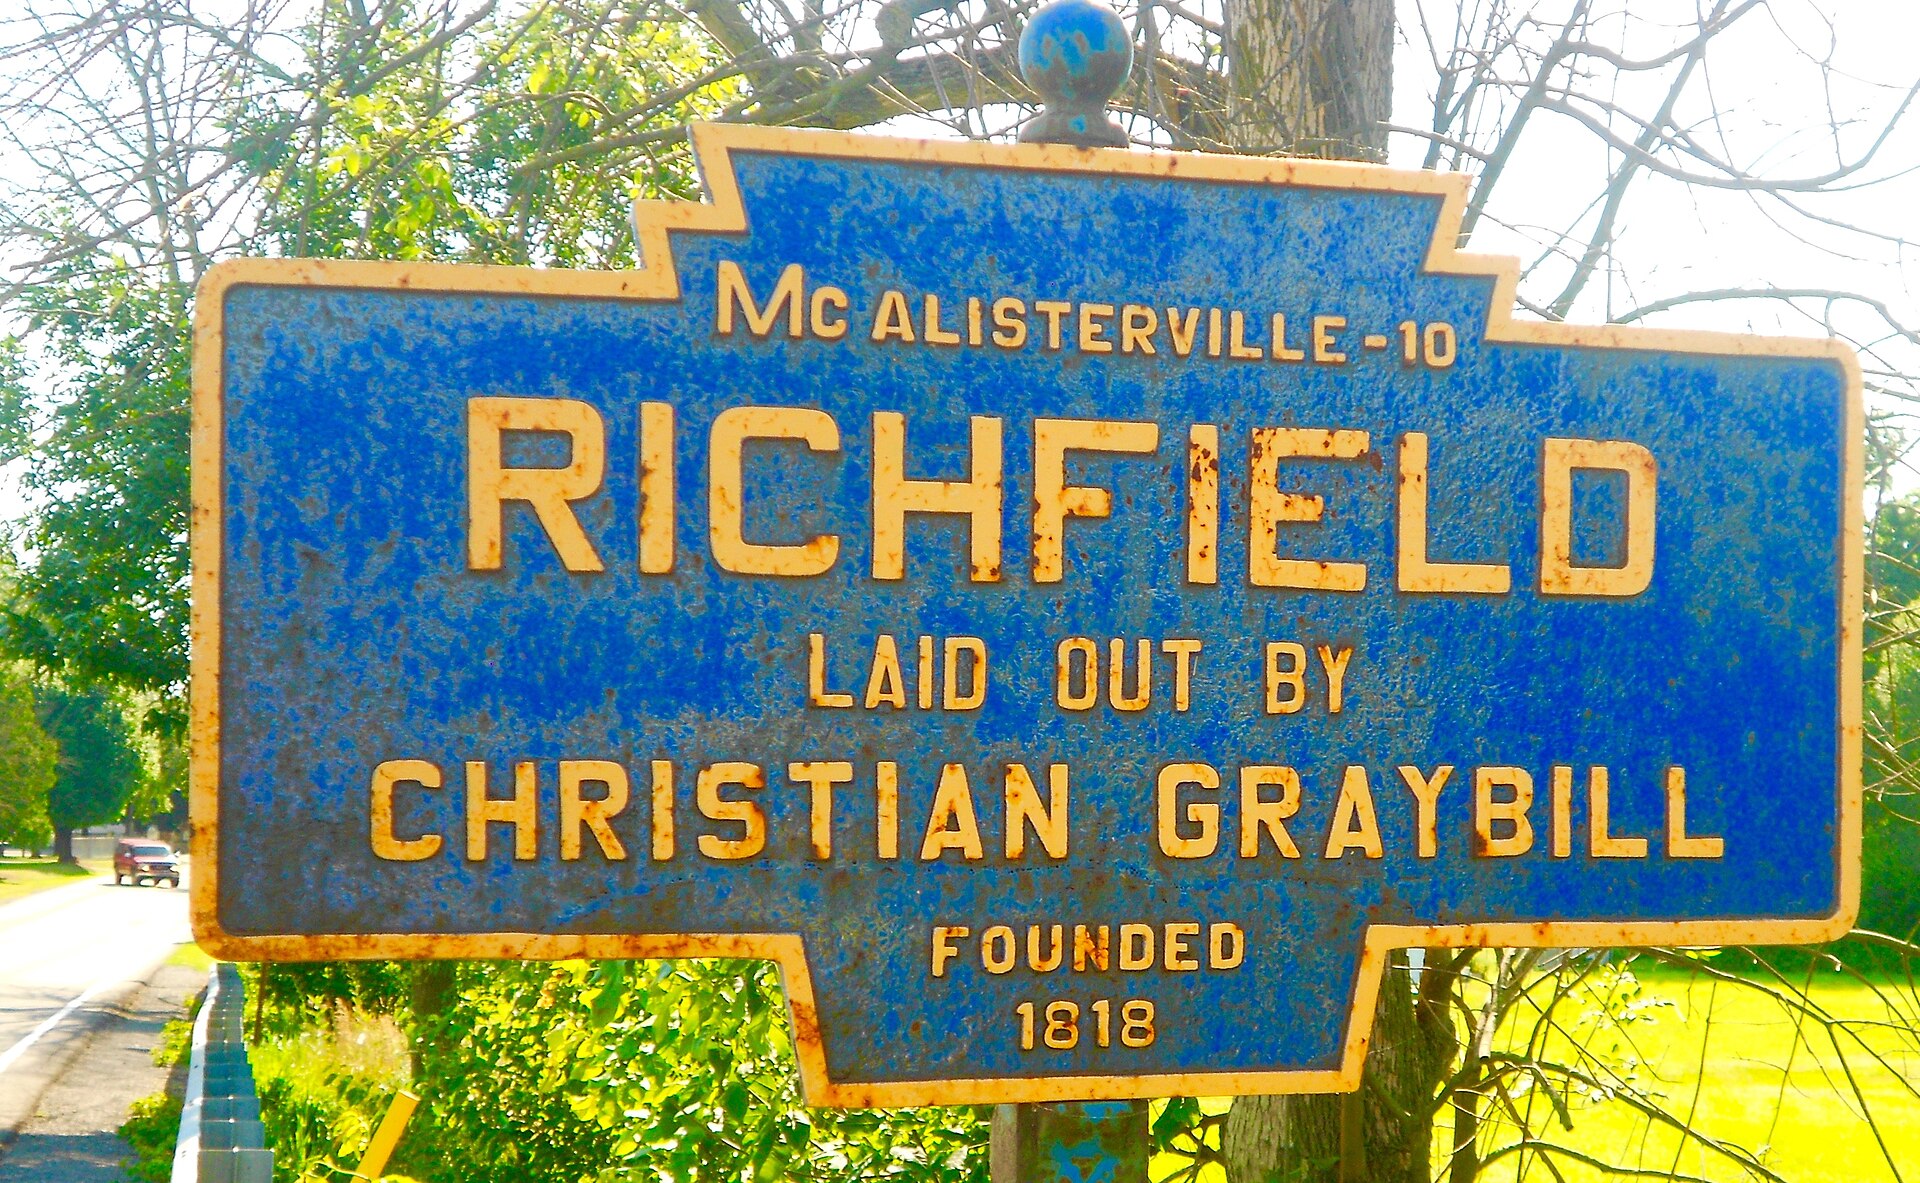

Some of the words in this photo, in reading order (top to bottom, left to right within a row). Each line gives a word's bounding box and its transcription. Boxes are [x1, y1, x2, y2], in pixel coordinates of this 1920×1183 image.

[465, 395, 1659, 599] RICHFIELD
[806, 632, 988, 713] LAID
[1054, 636, 1204, 714] OUT
[1262, 641, 1355, 717] BY
[369, 757, 1071, 863] CHRISTIAN
[1155, 763, 1726, 860] GRAYBILL
[929, 921, 1245, 978] FOUNDED
[1015, 999, 1156, 1051] 1818
